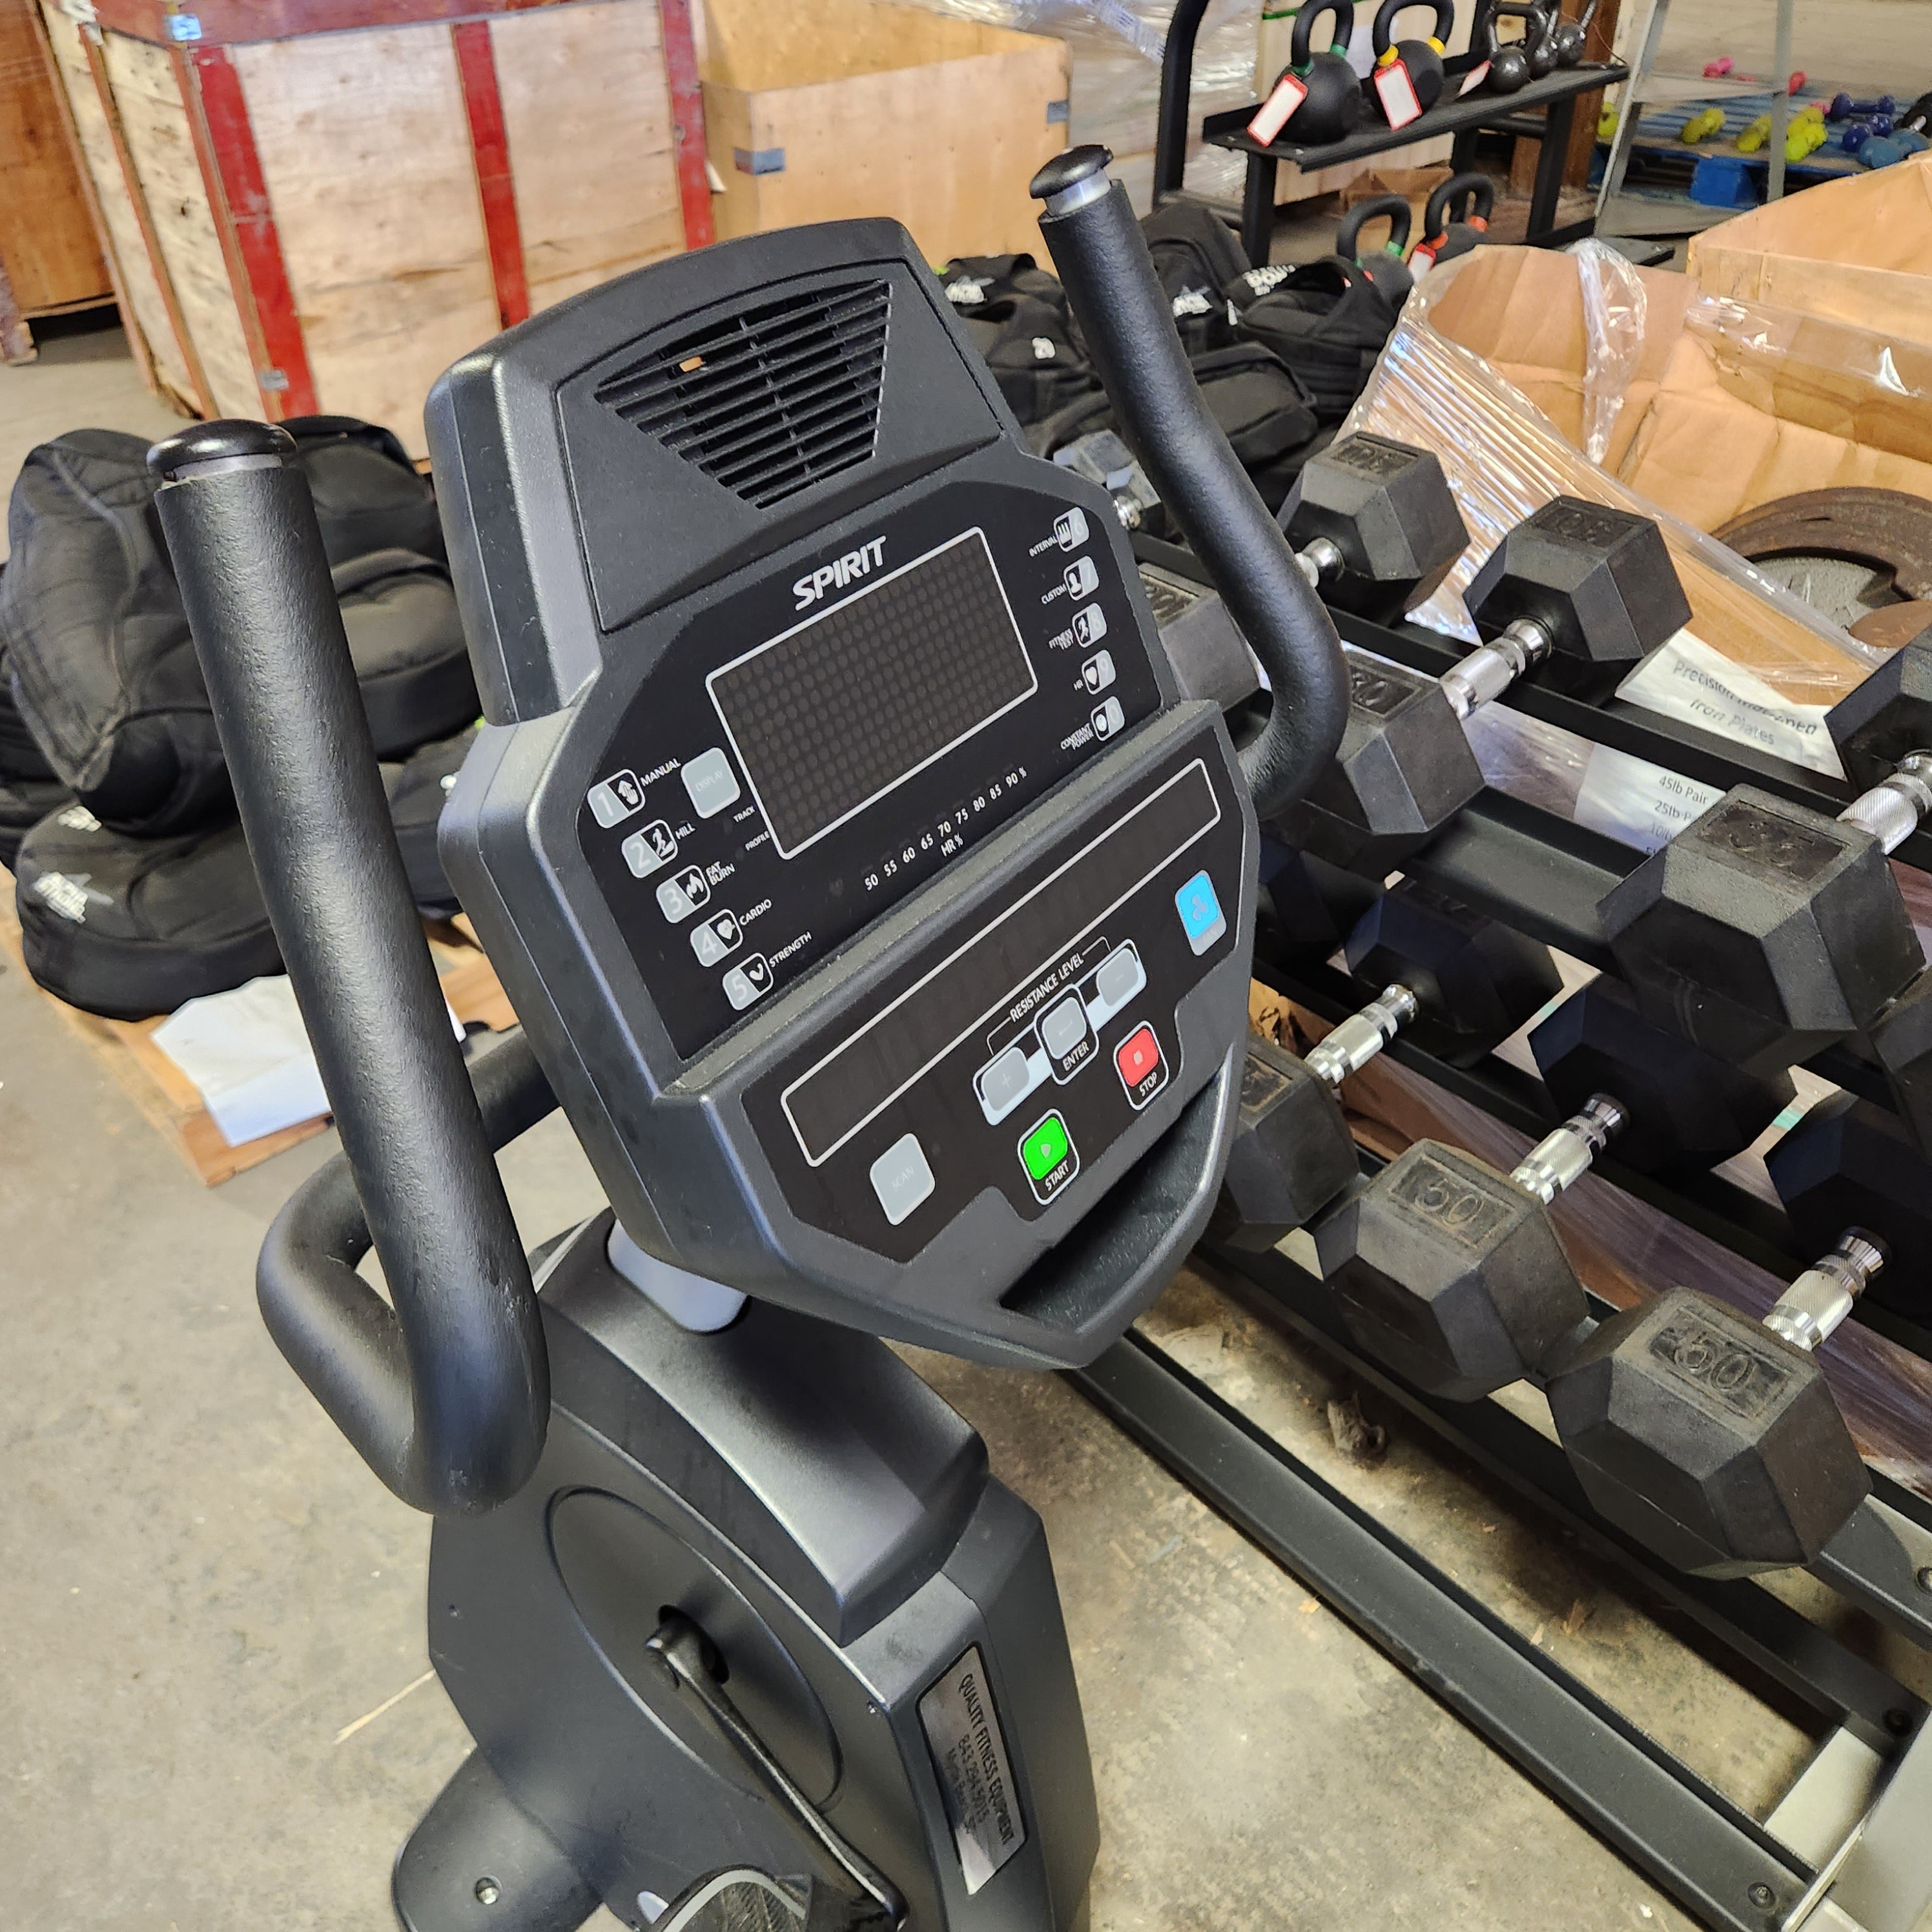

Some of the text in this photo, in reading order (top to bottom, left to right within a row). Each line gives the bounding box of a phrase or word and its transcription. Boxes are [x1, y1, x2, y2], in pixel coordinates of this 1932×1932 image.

[1029, 535, 1058, 557] INTERVAL
[793, 535, 887, 611] SPIRIT
[1041, 584, 1067, 604] CUSTOM
[1049, 628, 1073, 649] FITNESS
[1060, 635, 1074, 650] TEST
[1073, 679, 1084, 691] HR
[1673, 660, 1734, 701] Precision
[1690, 699, 1775, 746] Iron Plates
[1061, 723, 1091, 750] CONSTANT
[1072, 728, 1094, 750] POWER
[640, 758, 681, 786] MANUAL
[1659, 776, 1709, 805] 45lb Pair
[597, 792, 614, 817] 1
[733, 806, 755, 823] TRACK
[1654, 800, 1680, 819] 25lb
[675, 821, 696, 840] HILL
[745, 830, 770, 851] PROFILE
[864, 874, 879, 891] 50
[883, 859, 898, 877] 55
[902, 847, 916, 863] 60
[921, 834, 934, 850] 65
[937, 821, 951, 838] 70
[955, 808, 969, 825] 75
[972, 796, 985, 812] 80
[989, 784, 1002, 800] 85
[1005, 772, 1018, 788] 90
[630, 842, 651, 869] 2
[941, 833, 963, 857] HR %
[706, 861, 721, 877] FAT
[710, 863, 735, 885] BURN
[664, 888, 683, 914] 3
[739, 898, 772, 925] CARDIO
[701, 930, 717, 955] 4
[770, 931, 812, 967] STRENGTH
[732, 974, 748, 1002] 5
[1009, 952, 1085, 1023] RESISTANCE LEVEL
[1062, 1041, 1090, 1072] ENTER
[1139, 1071, 1158, 1097] STOP
[1045, 1160, 1069, 1191] START
[1415, 1176, 1485, 1227] 50
[958, 1673, 985, 1729] QUALITY
[975, 1727, 998, 1781] FITNESS
[989, 1778, 1014, 1845] EQUIPMENT
